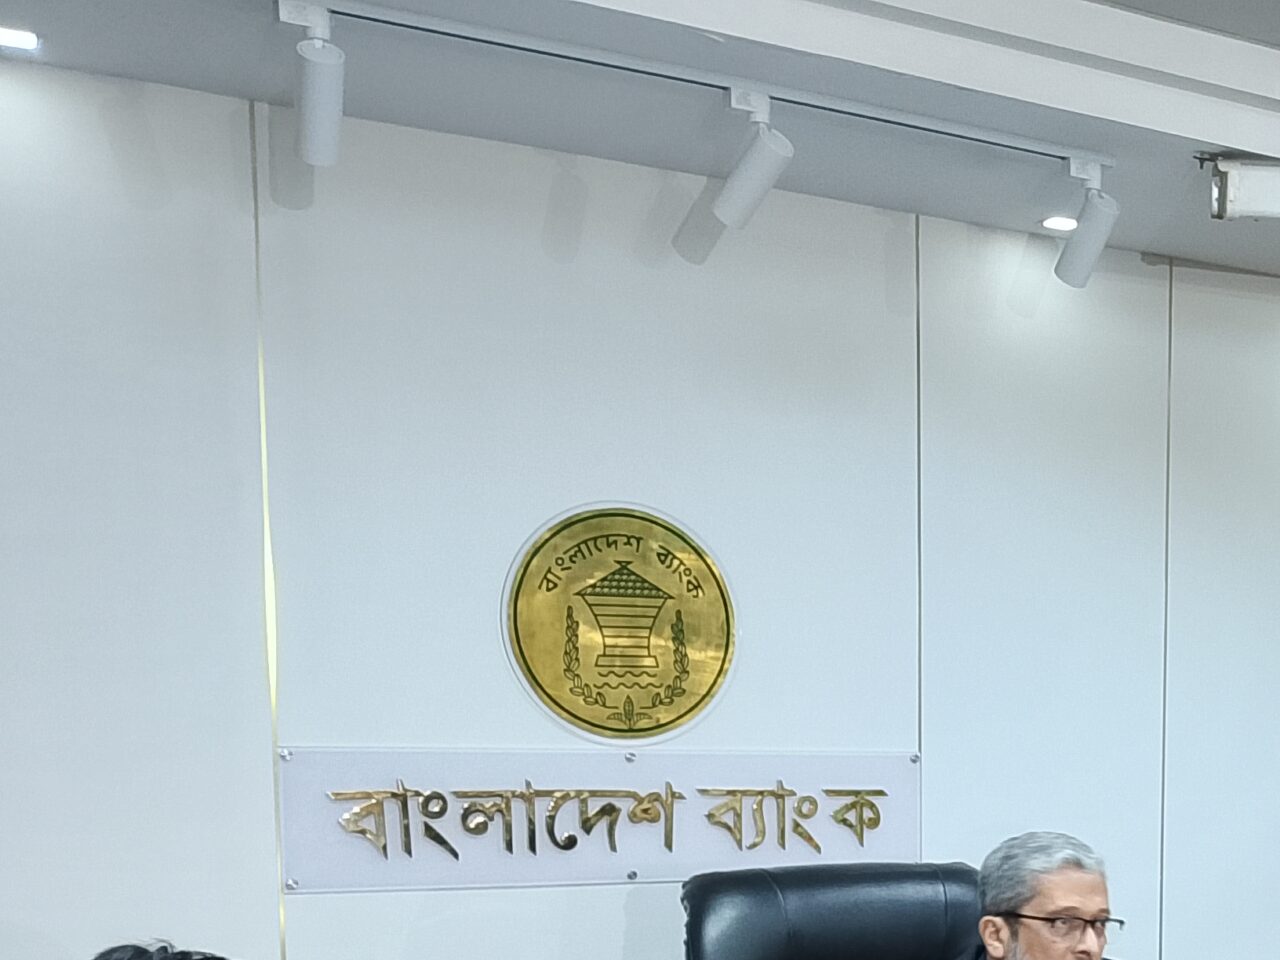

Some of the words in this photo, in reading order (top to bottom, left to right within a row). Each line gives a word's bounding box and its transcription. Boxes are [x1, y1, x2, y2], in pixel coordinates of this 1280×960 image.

[538, 533, 644, 593] বাংলাদেশ
[656, 544, 705, 599] ব্যাংক
[326, 778, 687, 861] বাংলাদেশ
[696, 778, 890, 855] ব্যাংক
